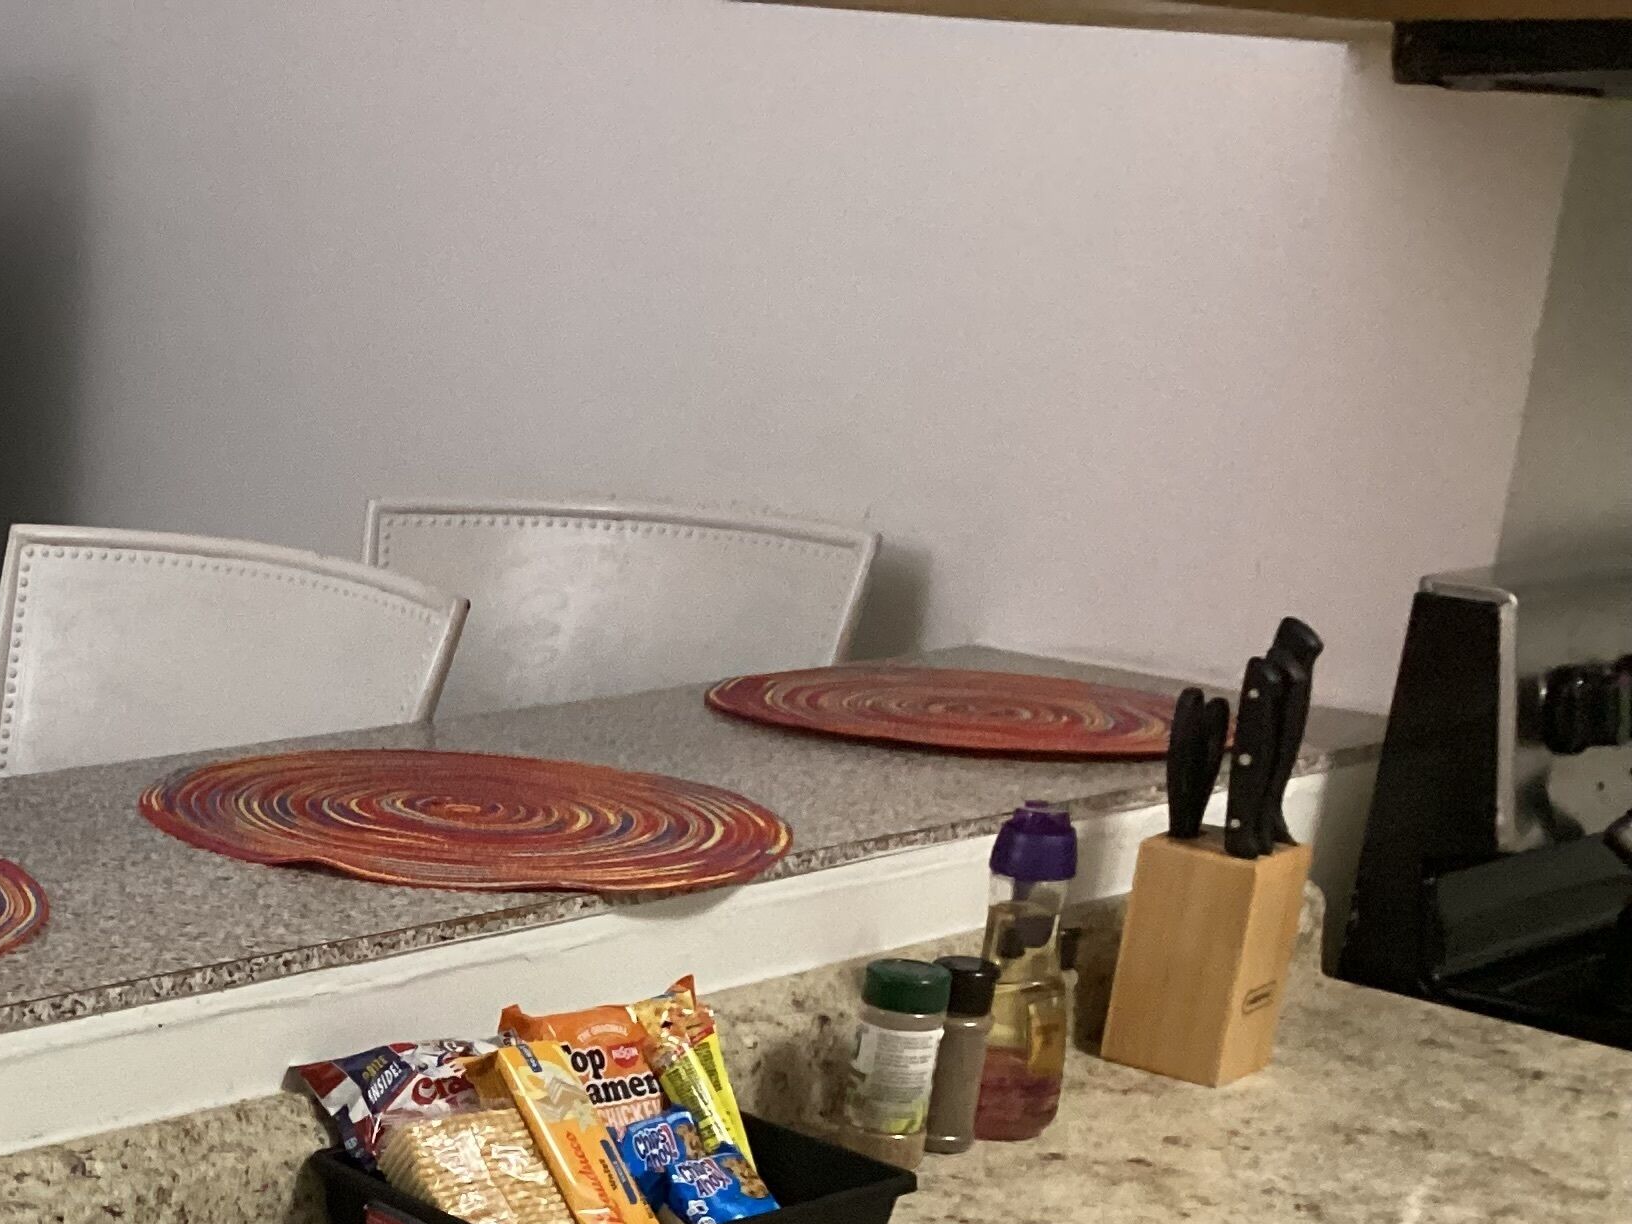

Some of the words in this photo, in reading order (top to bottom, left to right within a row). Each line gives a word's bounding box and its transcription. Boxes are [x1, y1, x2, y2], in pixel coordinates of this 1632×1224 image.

[367, 1061, 402, 1104] INSIDE!
[585, 1074, 664, 1105] amen
[633, 1125, 669, 1160] Chips
